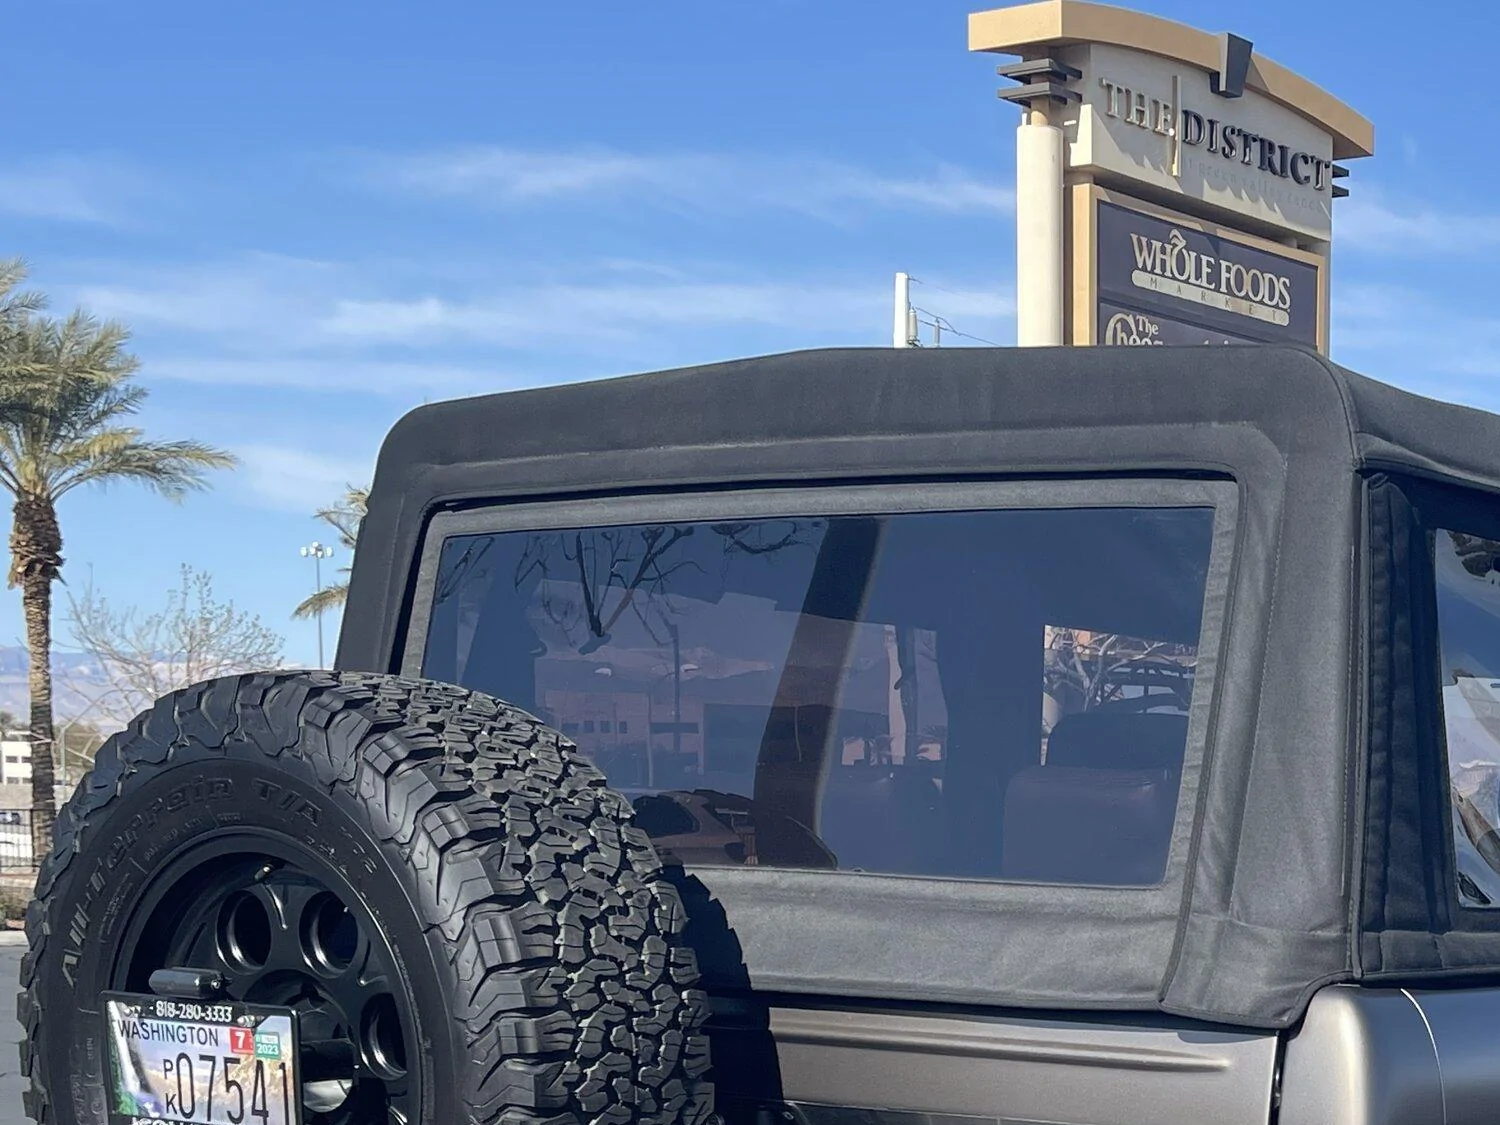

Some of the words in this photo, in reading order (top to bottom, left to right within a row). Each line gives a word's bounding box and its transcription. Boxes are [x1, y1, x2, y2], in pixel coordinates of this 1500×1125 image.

[1099, 77, 1173, 136] THE
[1181, 108, 1332, 192] DISTRICT
[1130, 229, 1215, 289] WHOLE
[1219, 259, 1291, 309] FOODS
[1150, 276, 1277, 320] MARKET
[1136, 315, 1159, 340] The
[156, 1002, 233, 1022] 818-280-3333
[116, 1020, 219, 1047] WASHINGTON
[235, 1031, 245, 1049] 7
[256, 1043, 279, 1055] 2023
